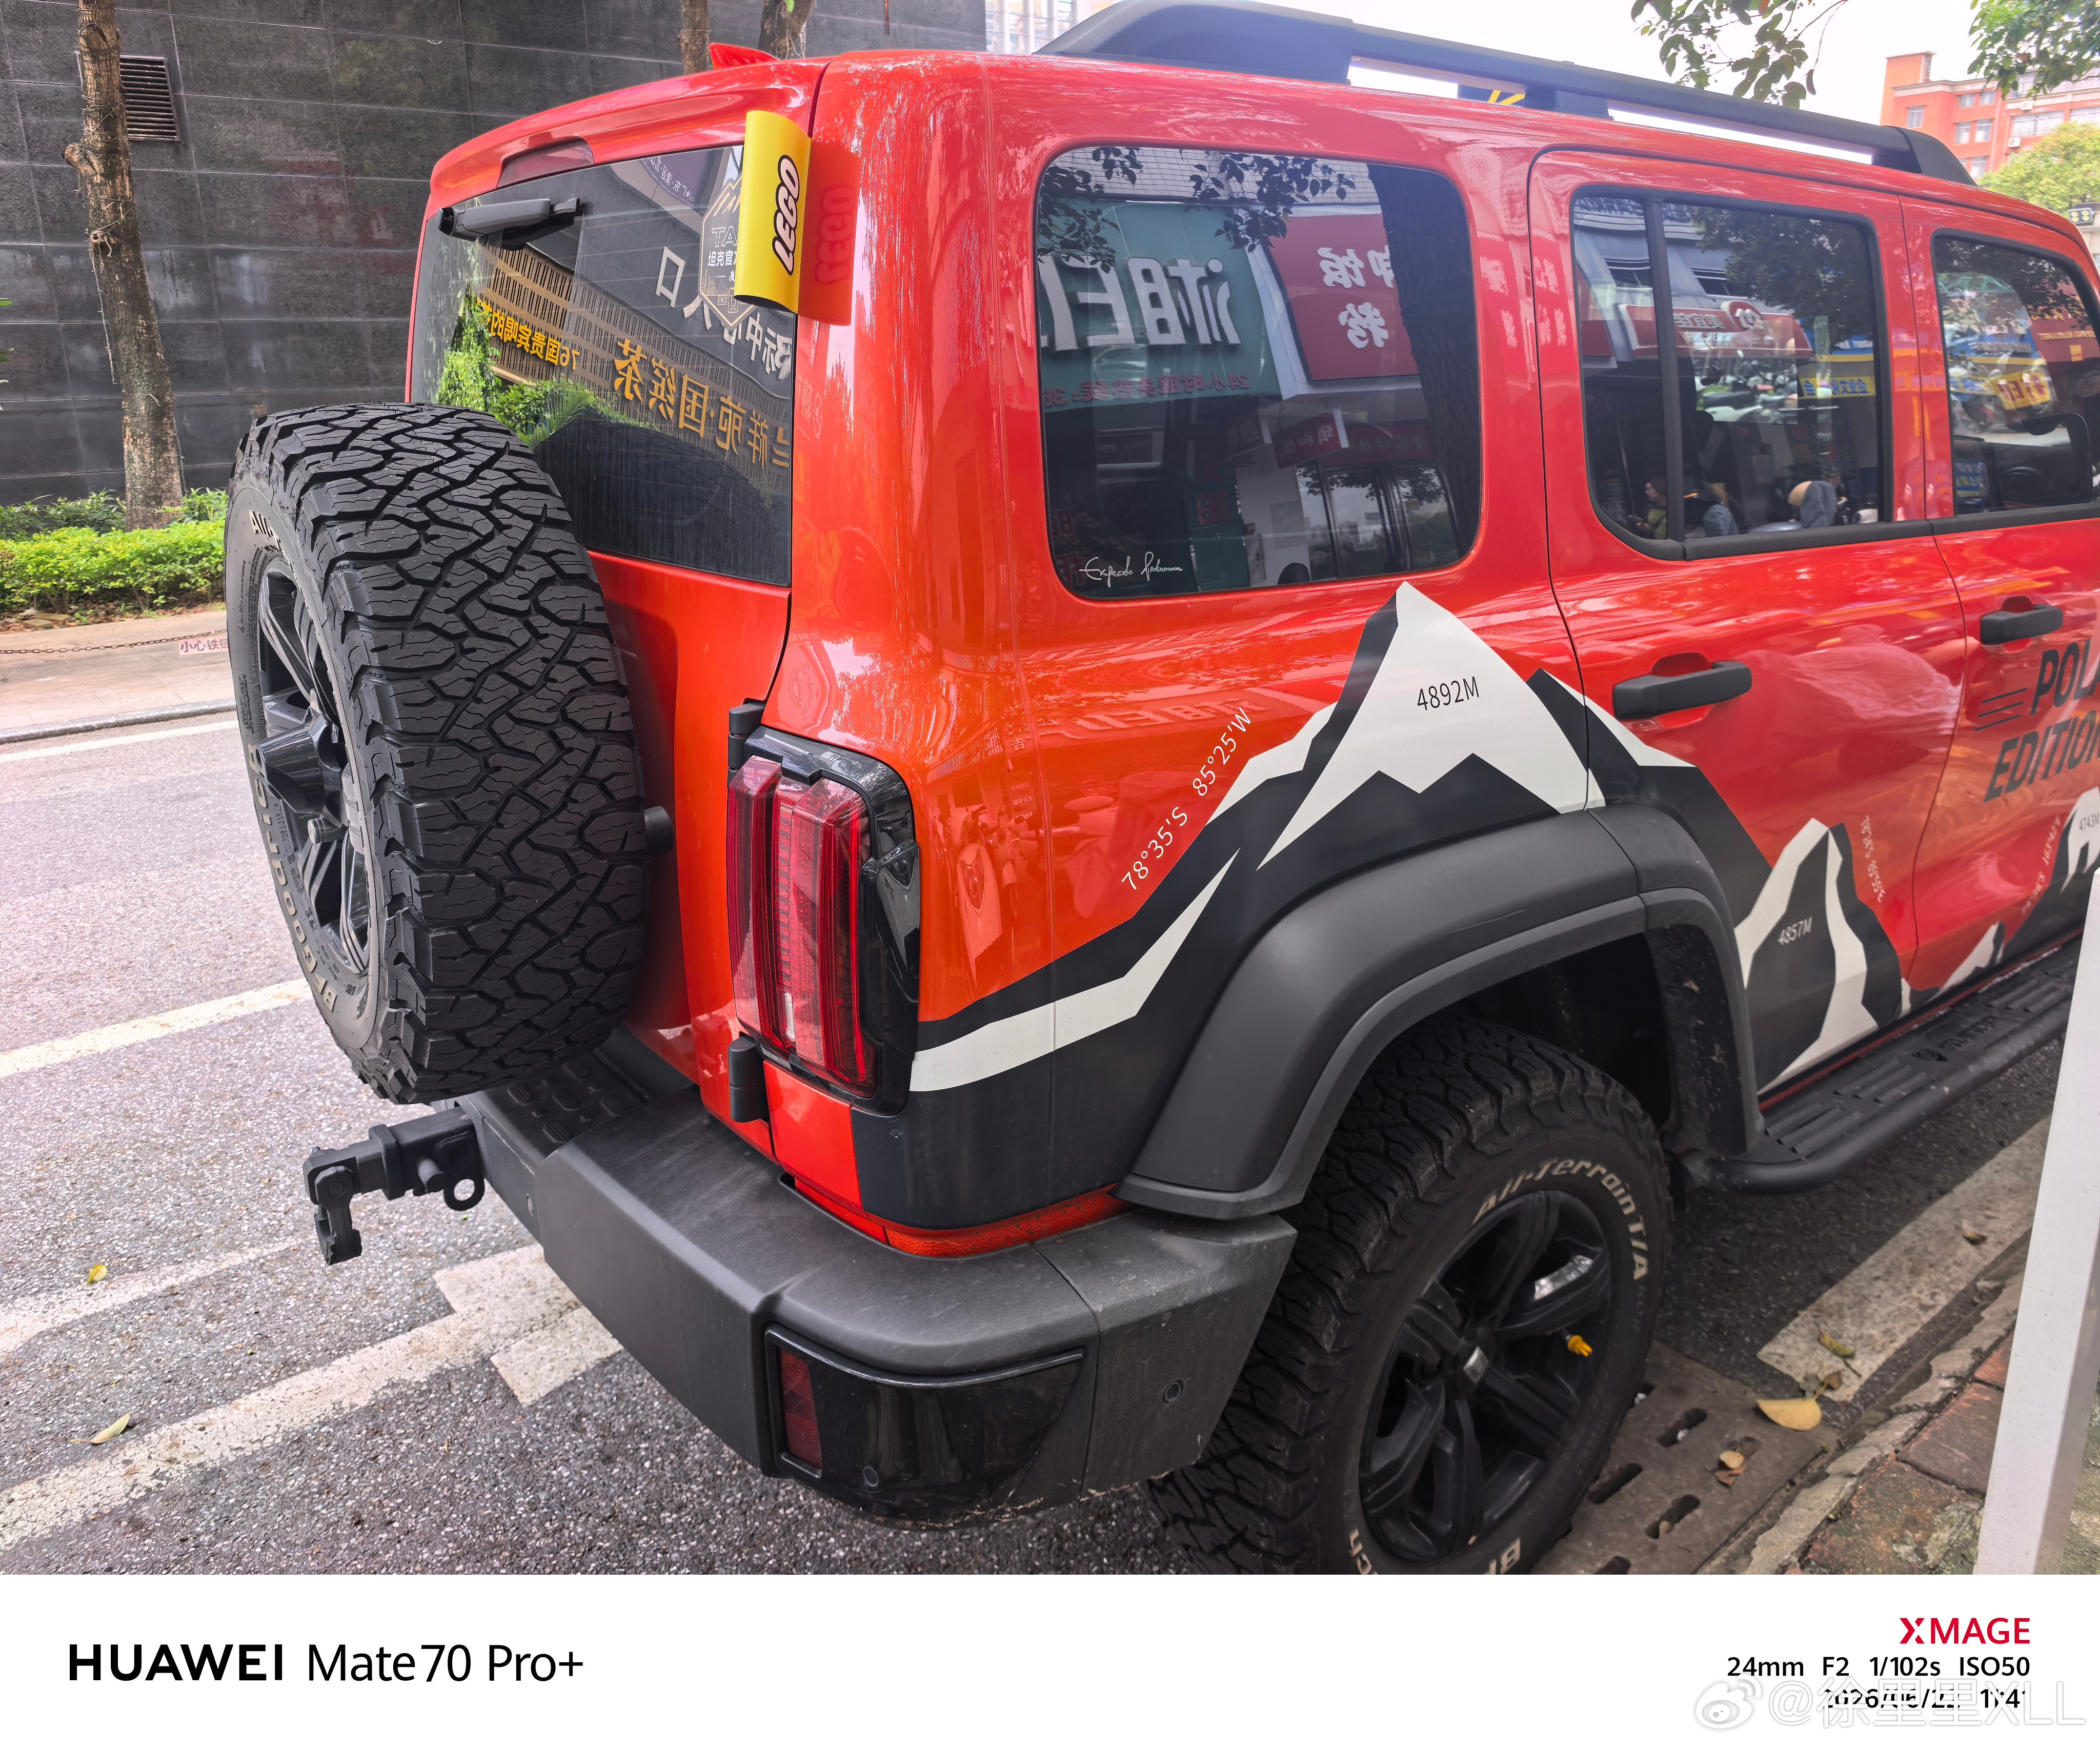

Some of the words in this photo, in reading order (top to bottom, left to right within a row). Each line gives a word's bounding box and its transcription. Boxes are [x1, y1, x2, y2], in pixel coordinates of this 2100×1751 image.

[772, 155, 800, 276] LEGO
[717, 295, 728, 304] SINCE
[1418, 676, 1479, 710] 4892M
[1121, 806, 1188, 890] 78°35'S
[1193, 707, 1251, 796] 85°25'W
[1472, 1157, 1636, 1226] All-Terrain
[1628, 1215, 1648, 1281] T/A
